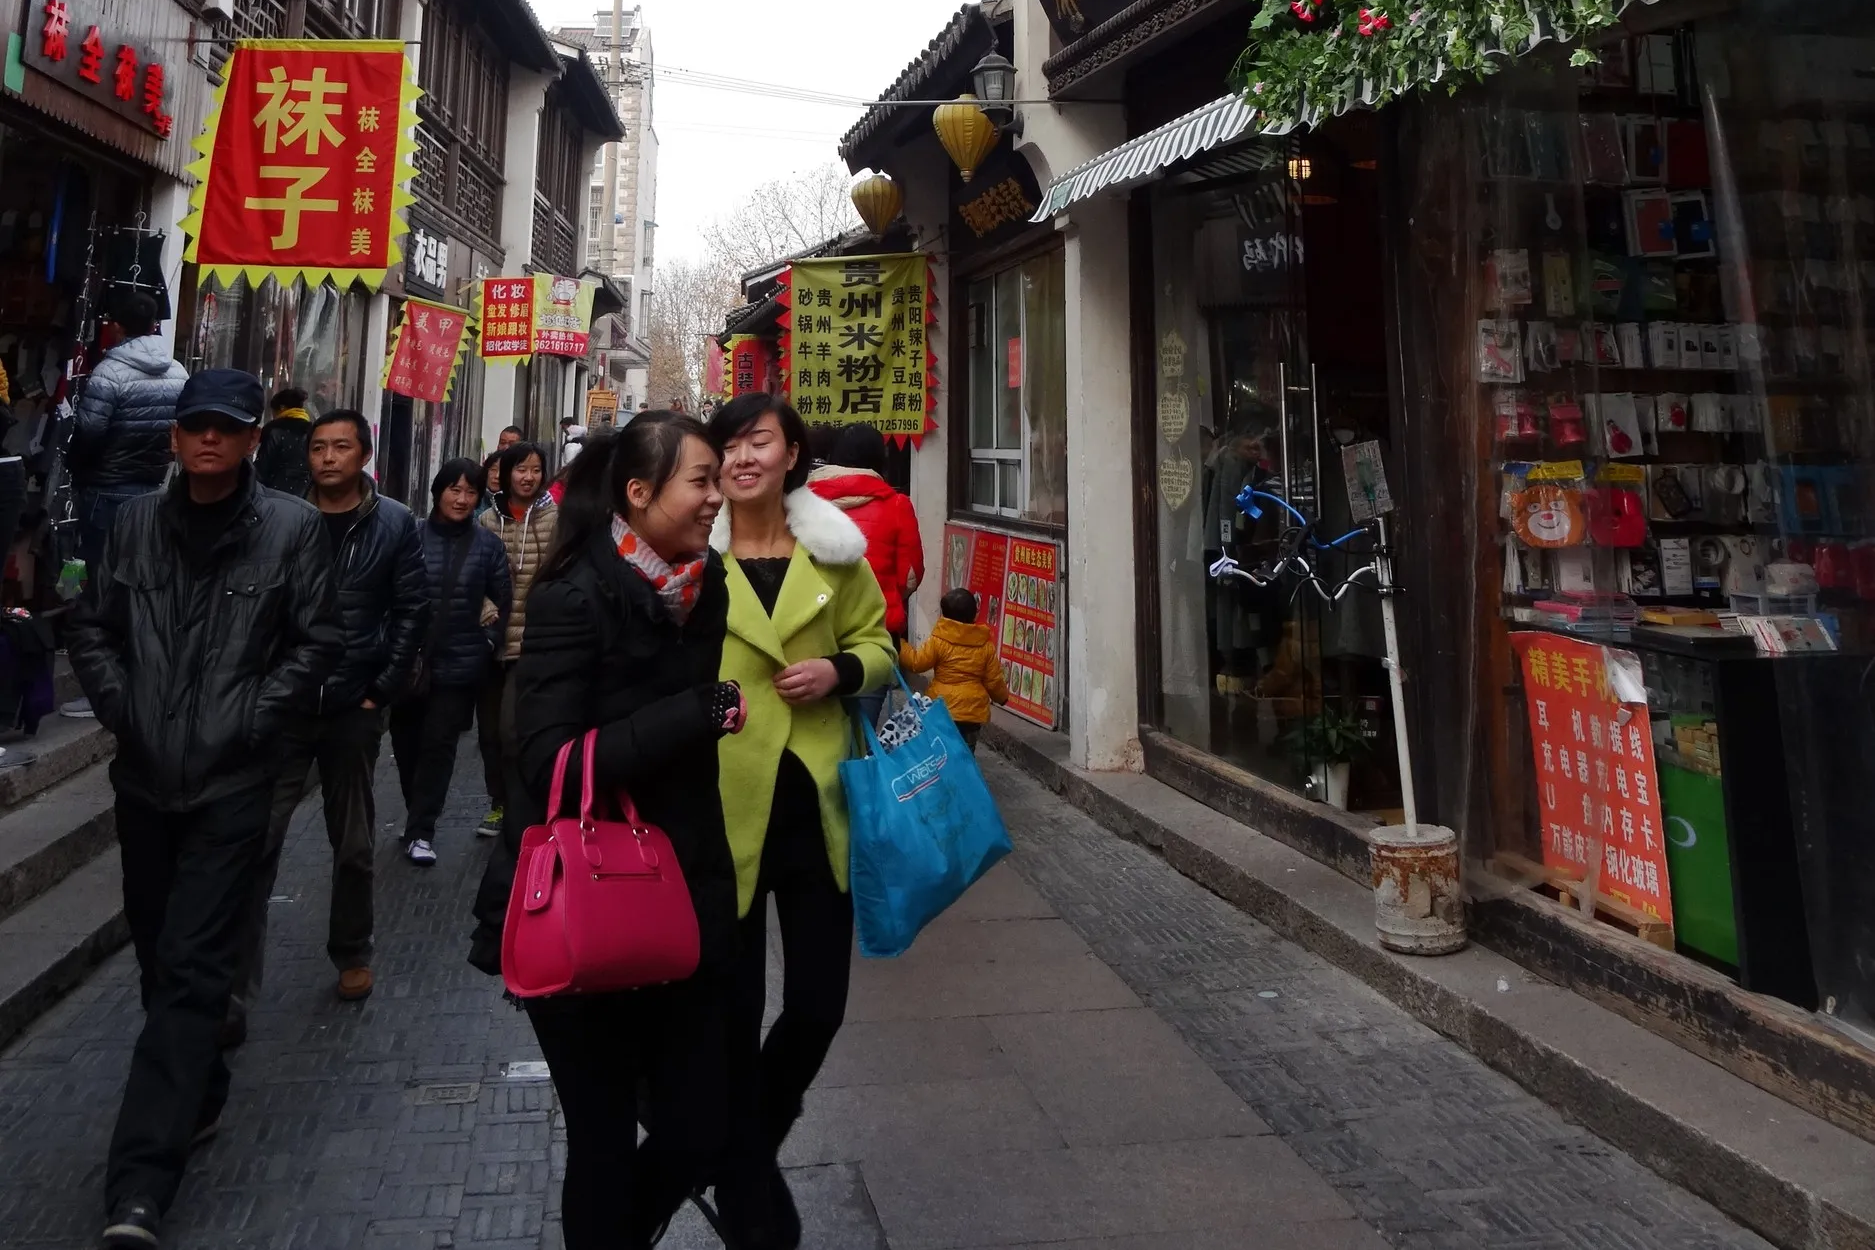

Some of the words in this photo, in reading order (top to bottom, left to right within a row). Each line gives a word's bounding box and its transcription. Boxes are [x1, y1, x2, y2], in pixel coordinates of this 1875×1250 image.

[244, 66, 348, 250] 袜子
[350, 106, 381, 256] 袜全袜美
[486, 303, 507, 319] 盘发
[509, 303, 529, 319] 修眉
[486, 321, 528, 337] 新娘跟妆
[486, 340, 528, 352] 招化妆学徒
[492, 283, 526, 300] 化妆
[797, 288, 814, 415] 砂锅牛肉粉
[816, 288, 833, 415] 贵州羊肉粉
[837, 260, 887, 415] 贵州米粉店
[891, 287, 906, 412] 贵州米豆腐
[907, 285, 923, 413] 贵阳辣子鸡粉
[737, 352, 754, 396] 古装
